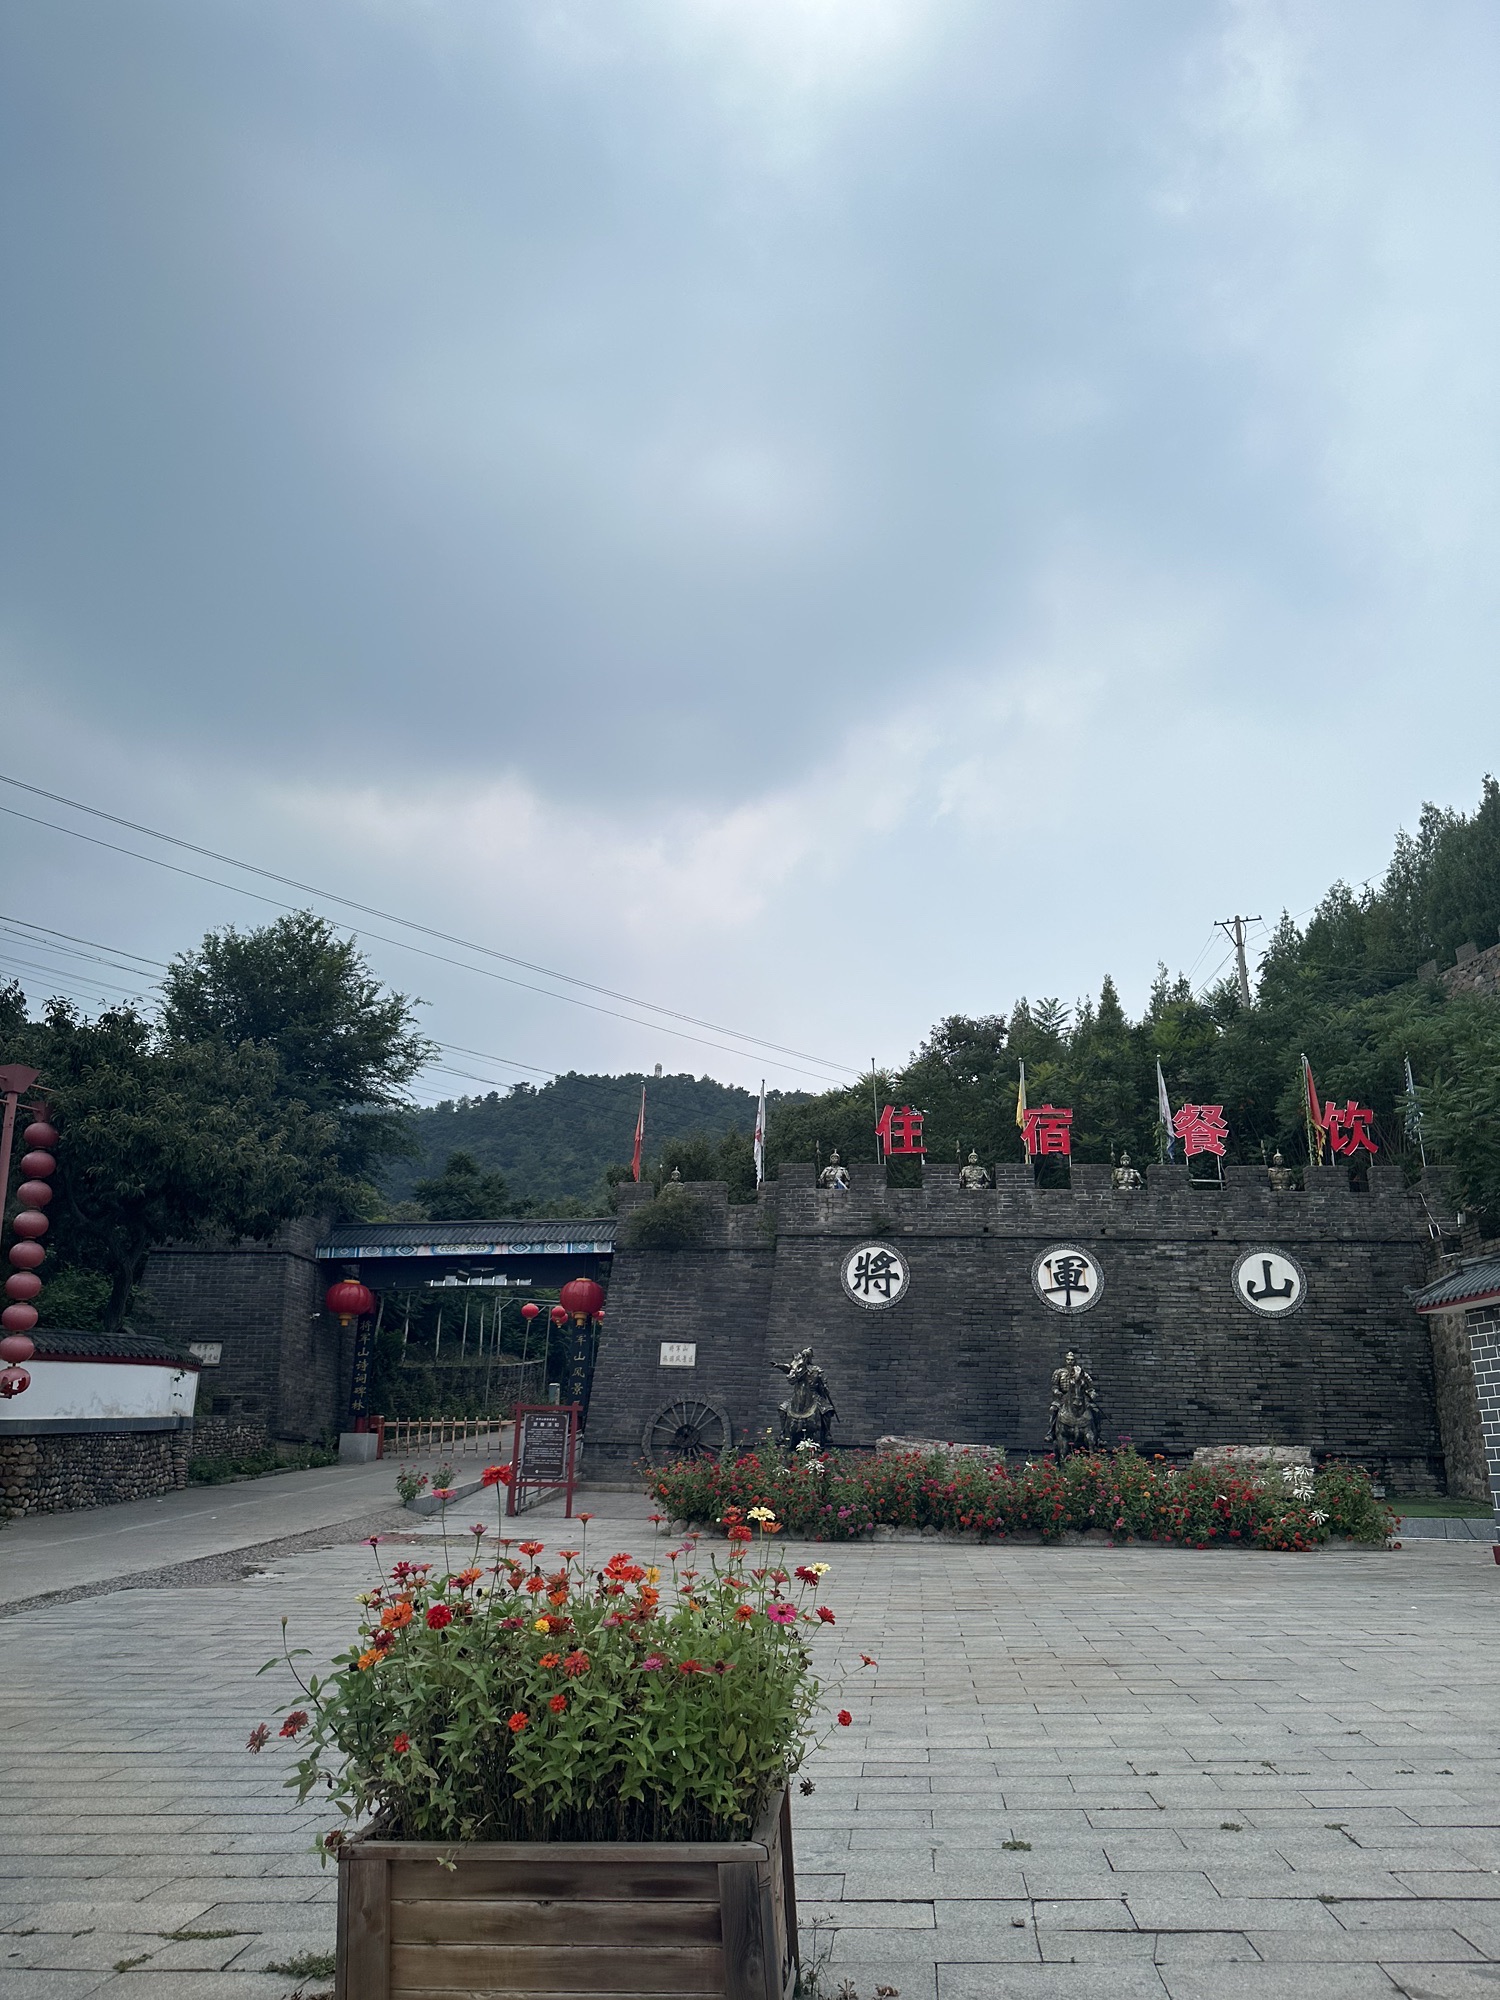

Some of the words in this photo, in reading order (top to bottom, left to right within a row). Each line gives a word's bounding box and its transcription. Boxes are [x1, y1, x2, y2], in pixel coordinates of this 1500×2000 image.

[875, 1100, 1379, 1156] 住宿餐饮
[351, 1320, 373, 1411] 将军山诗词碑林
[571, 1320, 588, 1403] 军山风景
